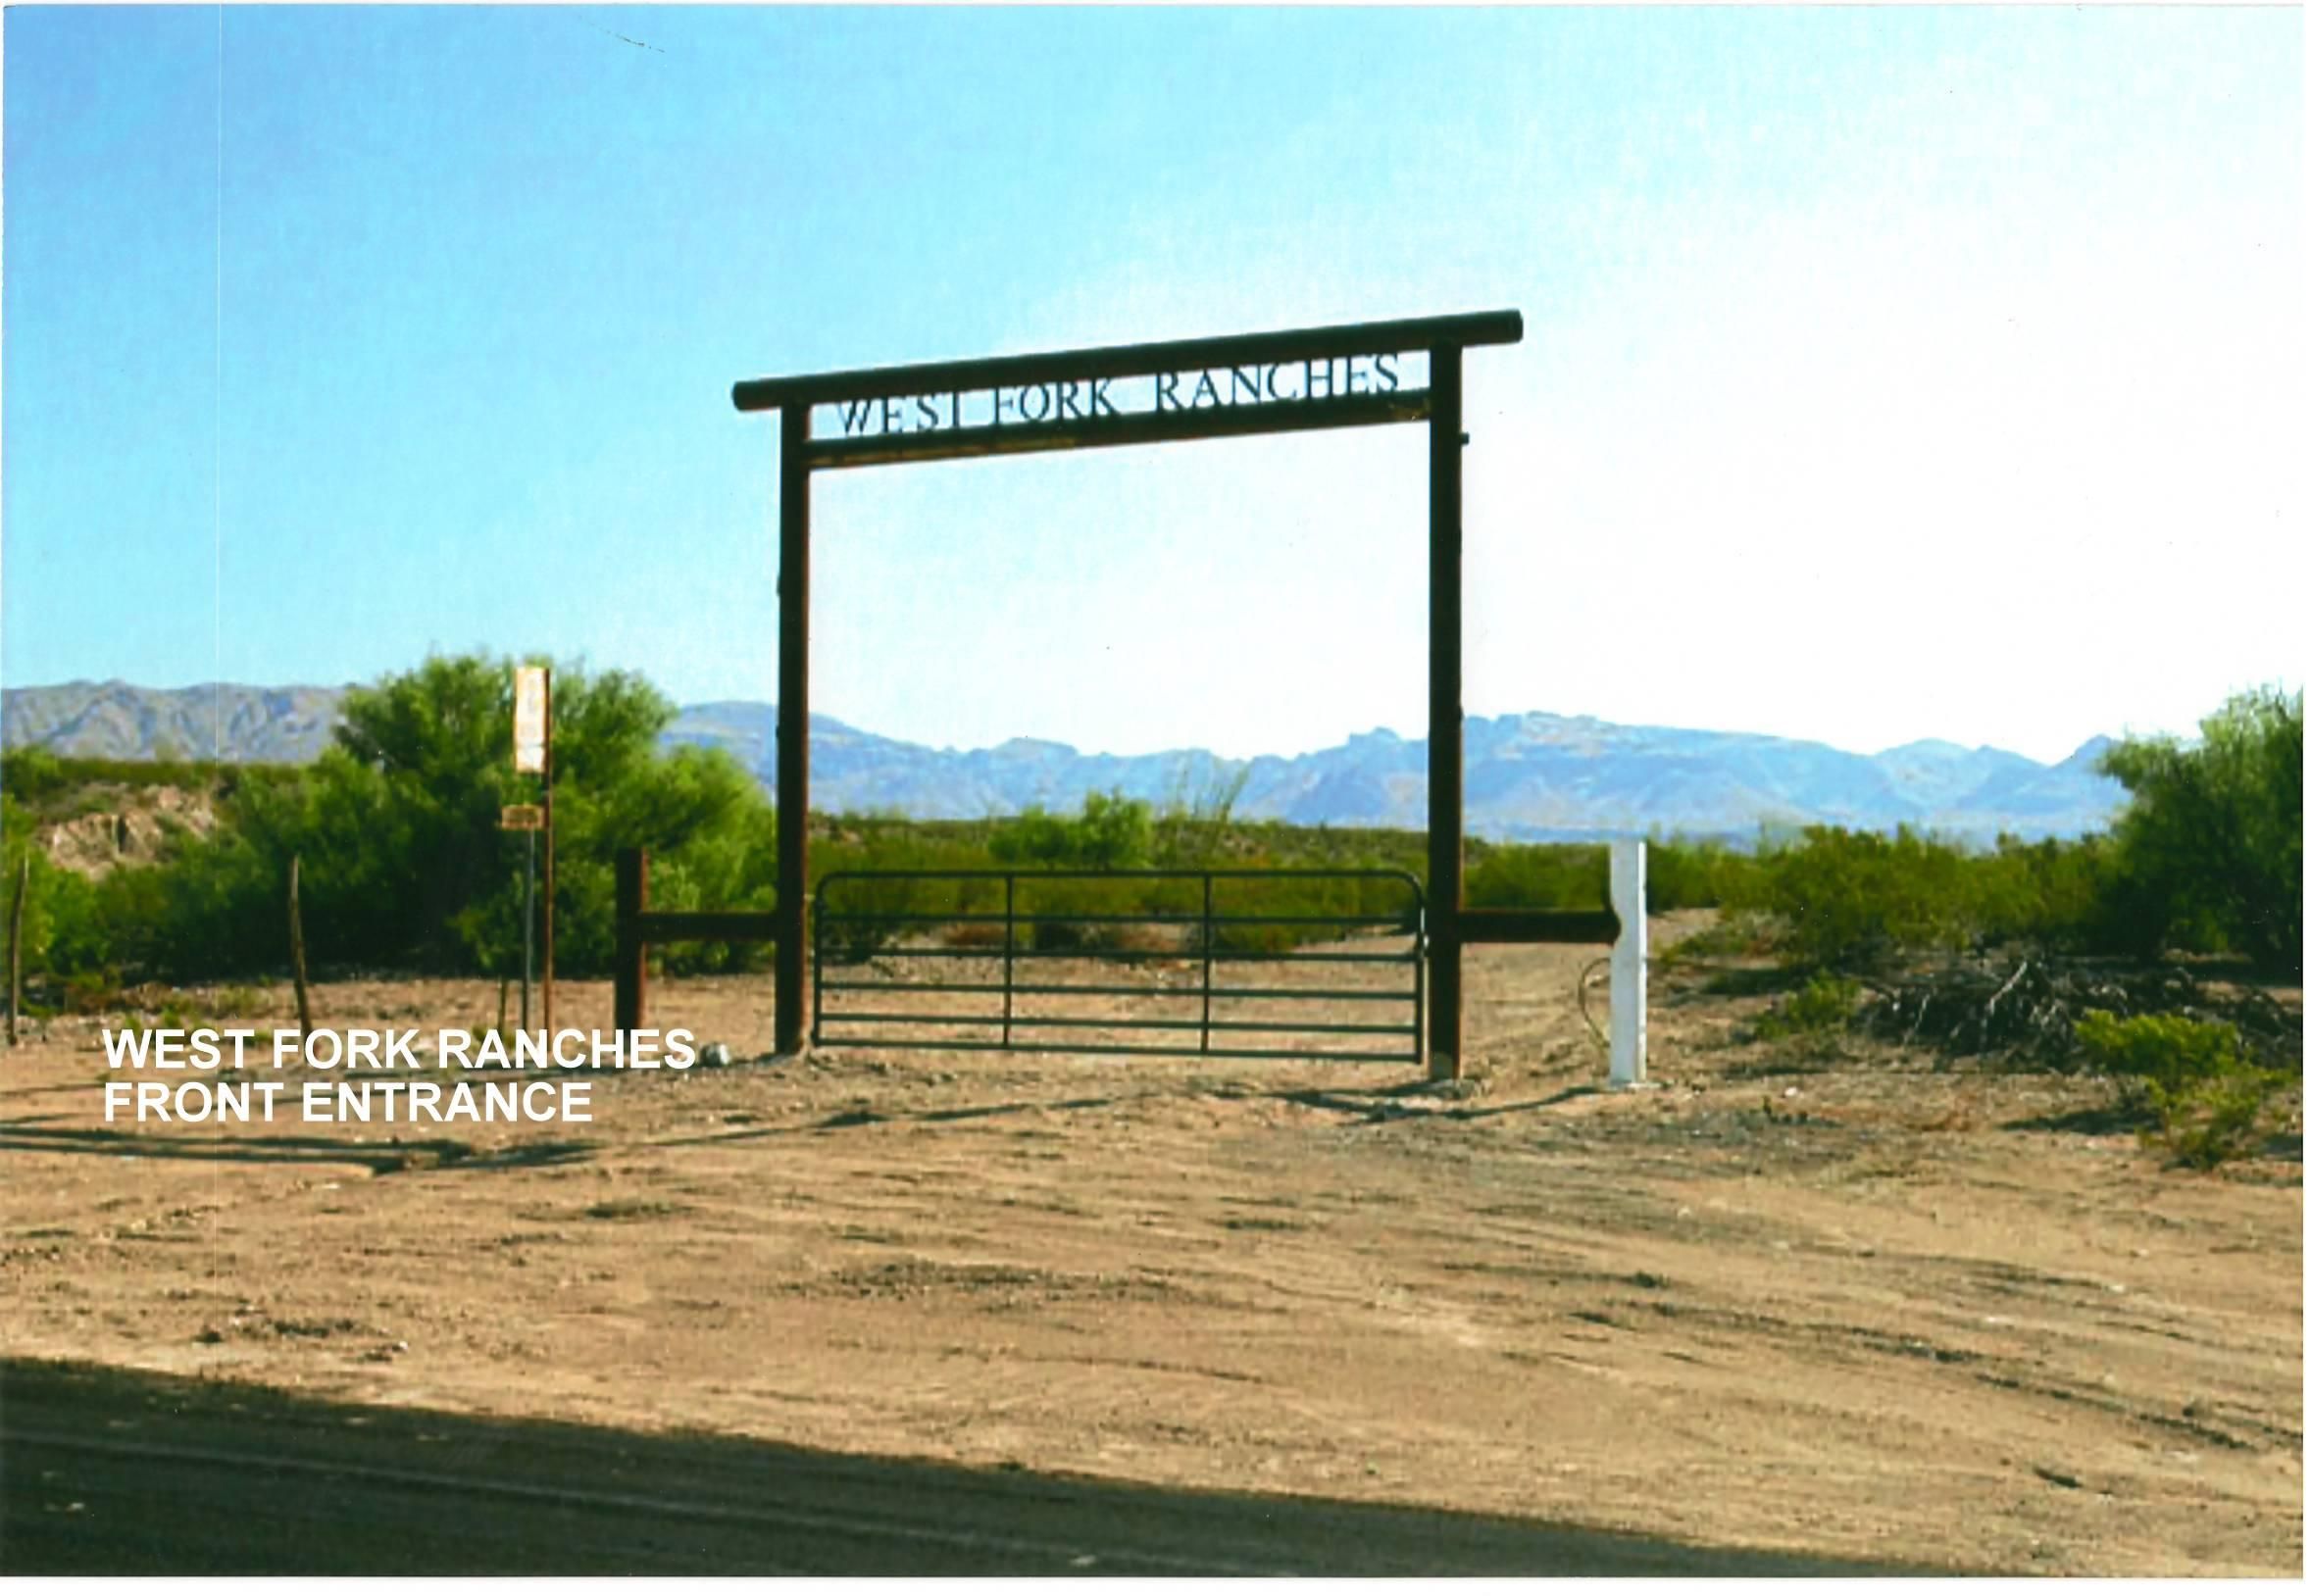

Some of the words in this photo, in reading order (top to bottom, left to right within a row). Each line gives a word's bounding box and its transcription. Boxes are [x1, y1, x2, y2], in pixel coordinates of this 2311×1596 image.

[836, 390, 965, 436] WEST
[991, 376, 1121, 427] FORK
[1154, 351, 1401, 417] RANCHES
